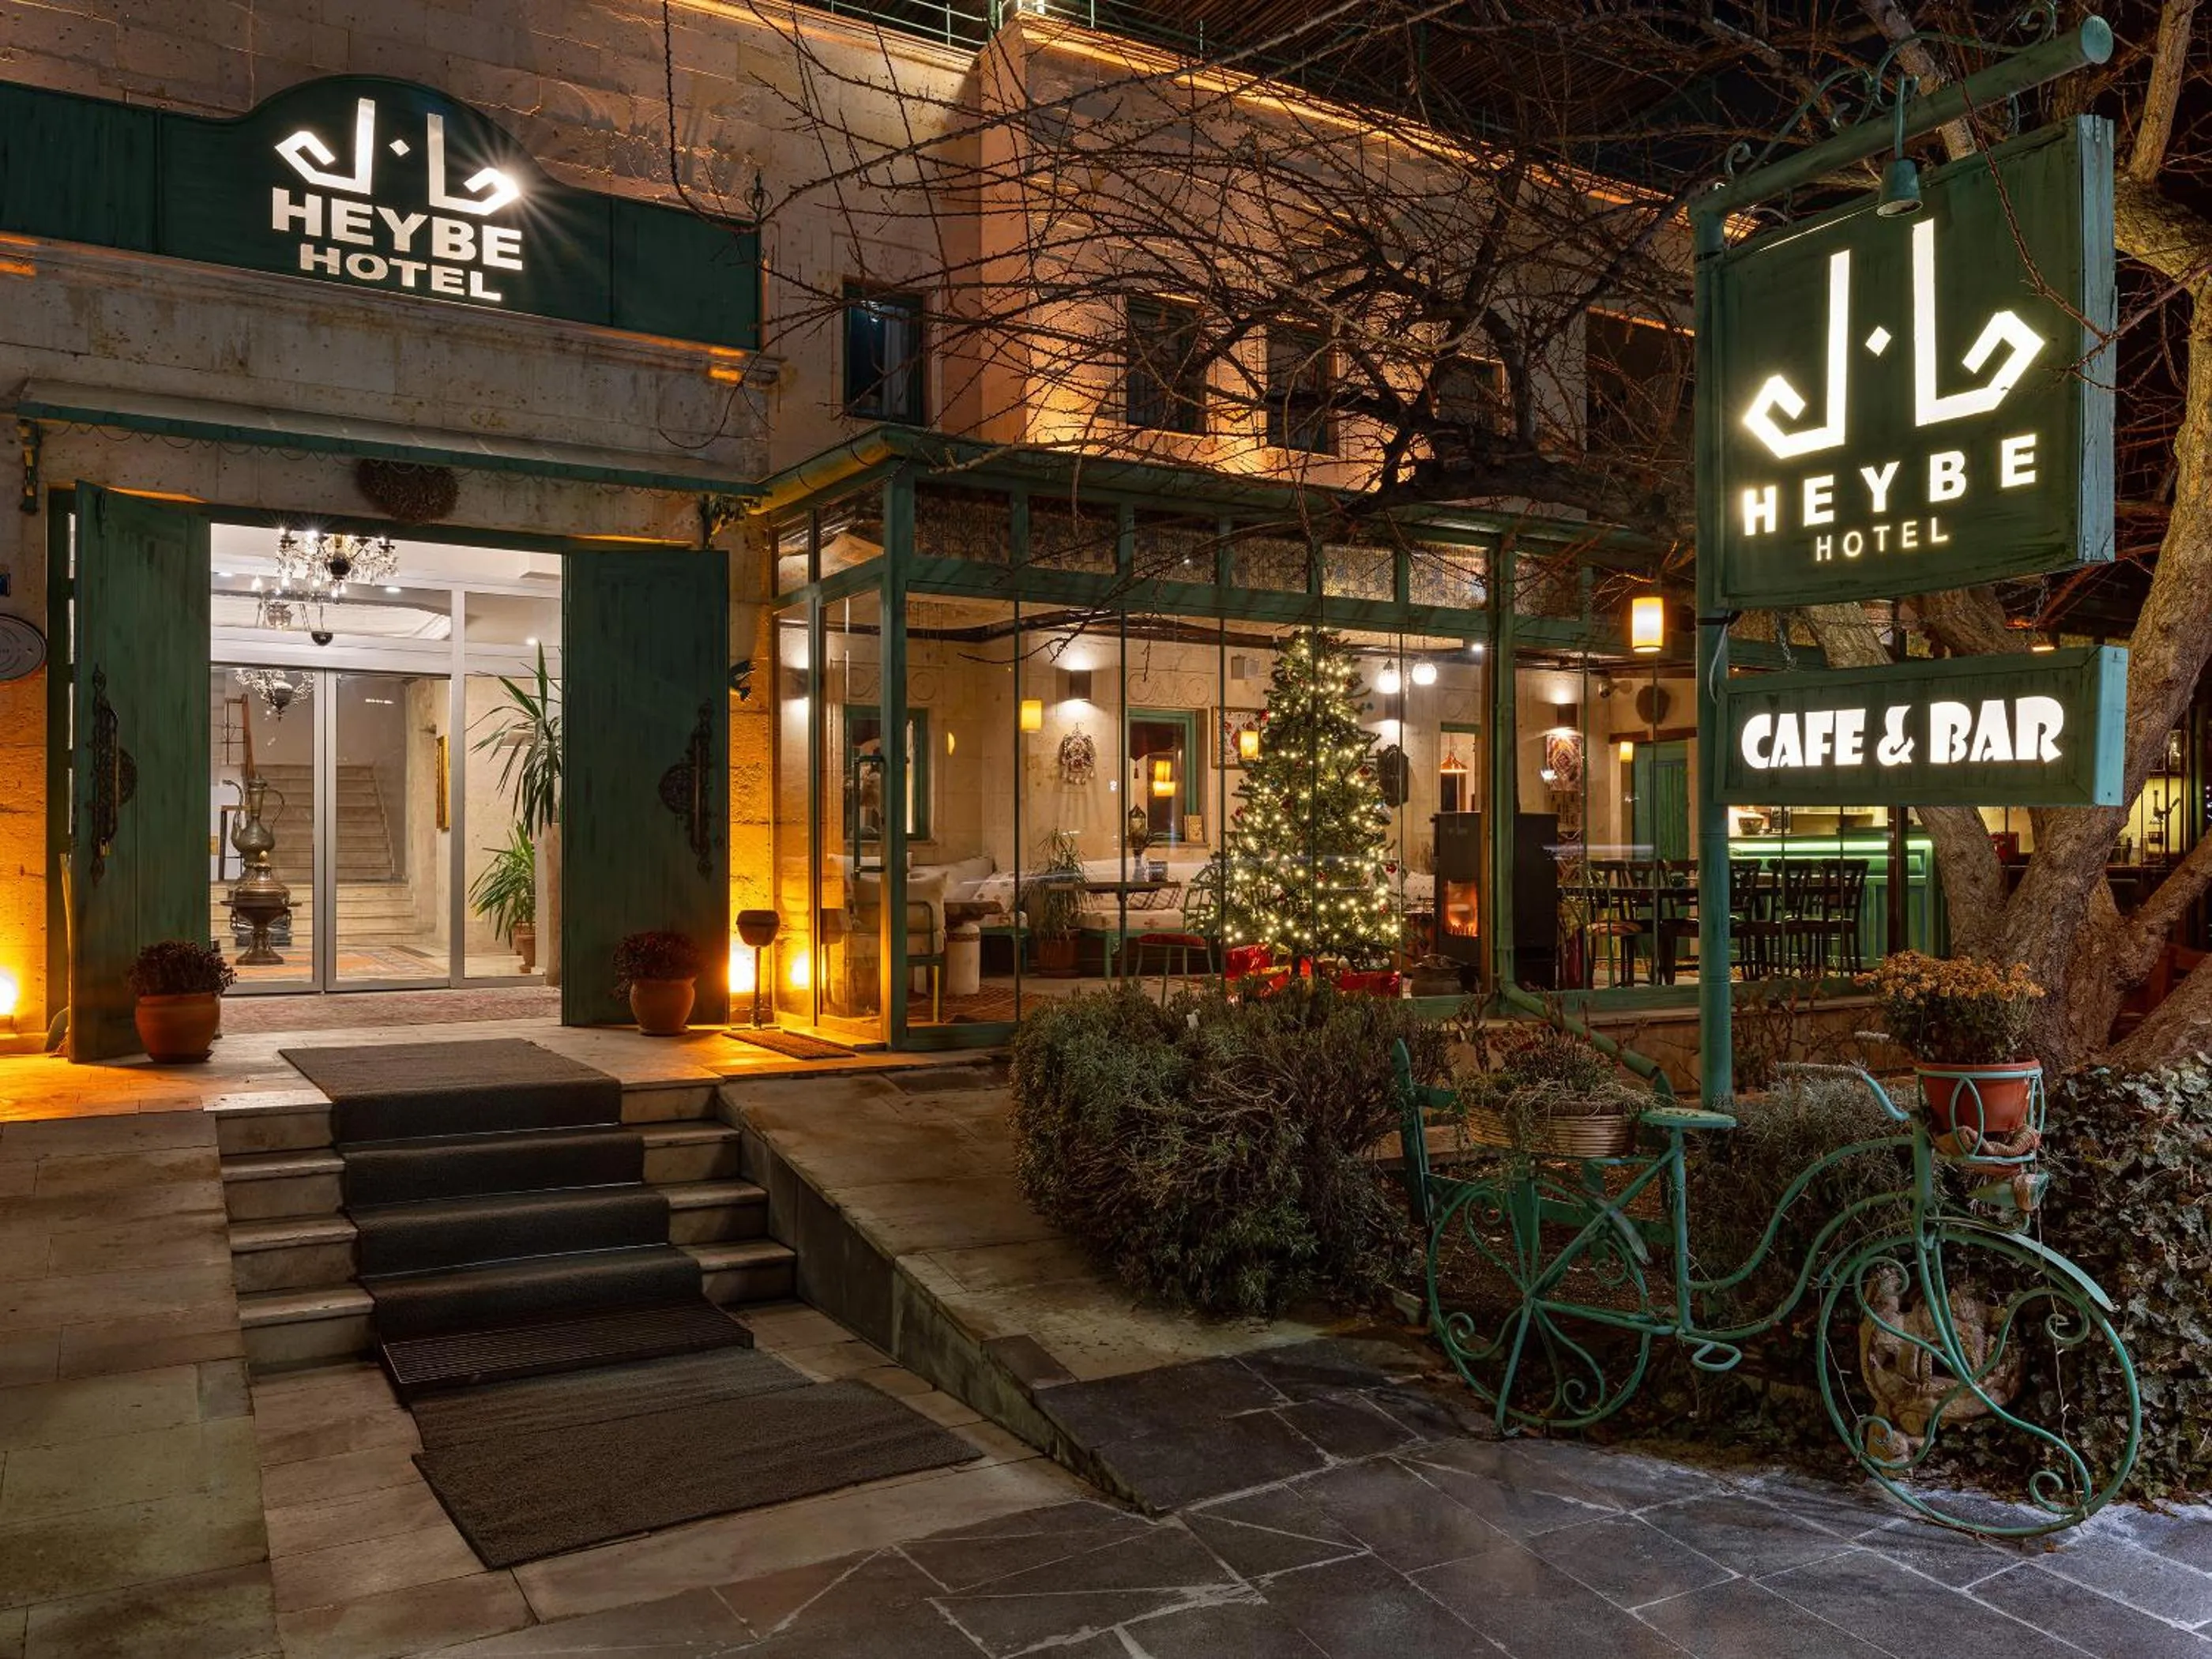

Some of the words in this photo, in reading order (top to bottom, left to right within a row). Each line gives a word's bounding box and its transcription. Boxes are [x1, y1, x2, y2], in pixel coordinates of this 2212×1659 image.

[272, 186, 524, 270] HEYBE
[299, 243, 502, 302] HOTEL
[1743, 434, 2037, 536] HEYBE
[1816, 517, 1950, 561] HOTEL
[1741, 708, 1867, 769] CAFE
[1876, 705, 1913, 766] &
[1929, 695, 2065, 765] BAR
